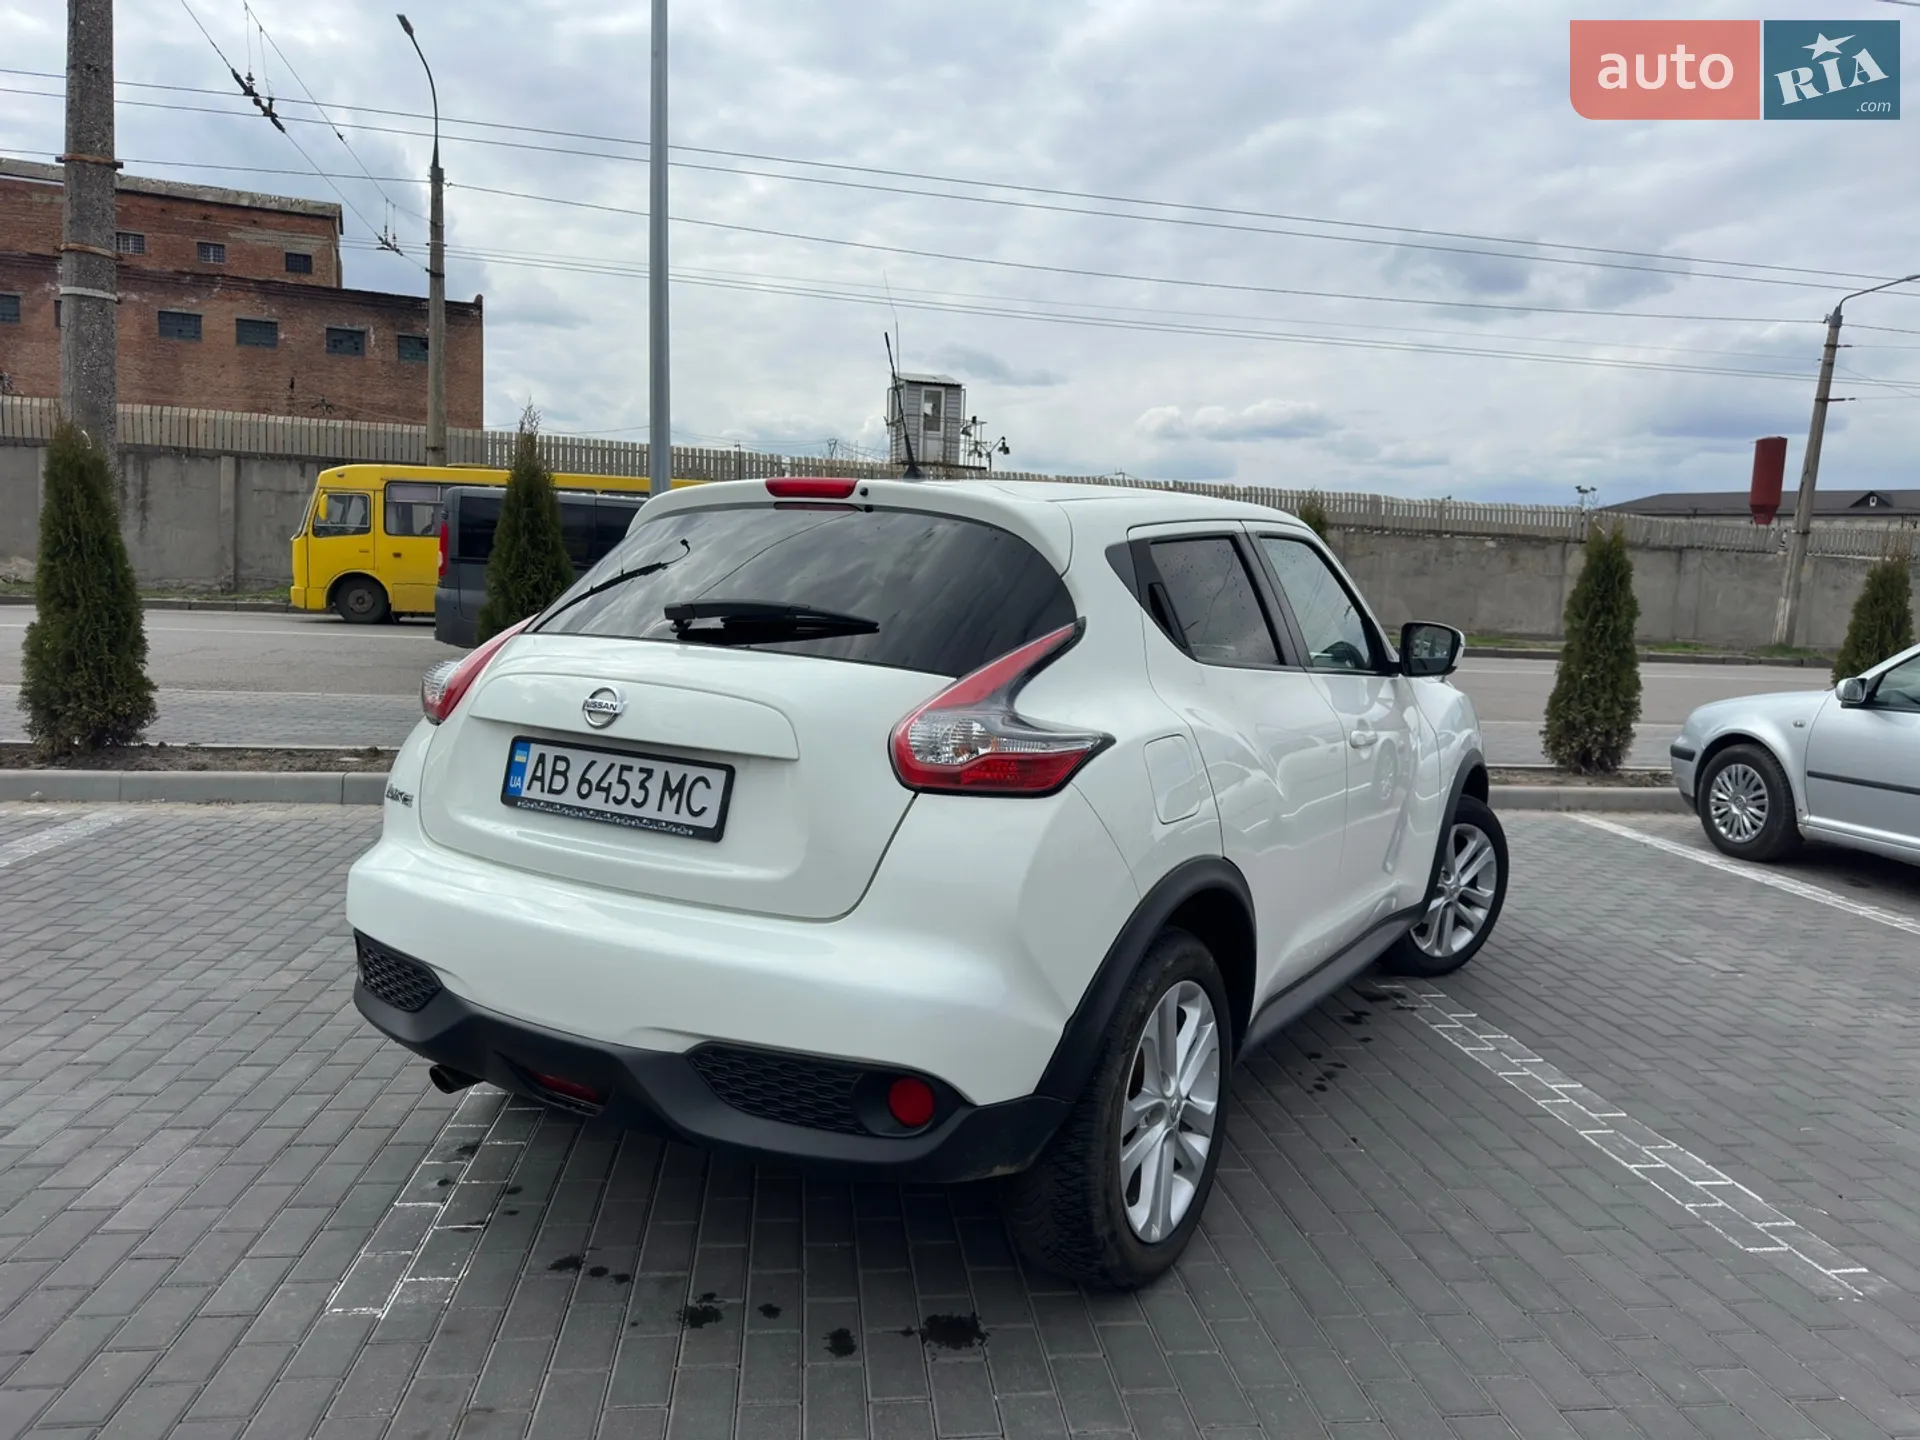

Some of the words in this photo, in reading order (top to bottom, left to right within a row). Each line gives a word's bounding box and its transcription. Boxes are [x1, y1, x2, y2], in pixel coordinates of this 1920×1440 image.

[584, 700, 618, 711] NISSAN
[510, 776, 522, 789] UA
[526, 752, 571, 795] AB
[576, 760, 654, 809] 6453
[657, 770, 712, 818] MC
